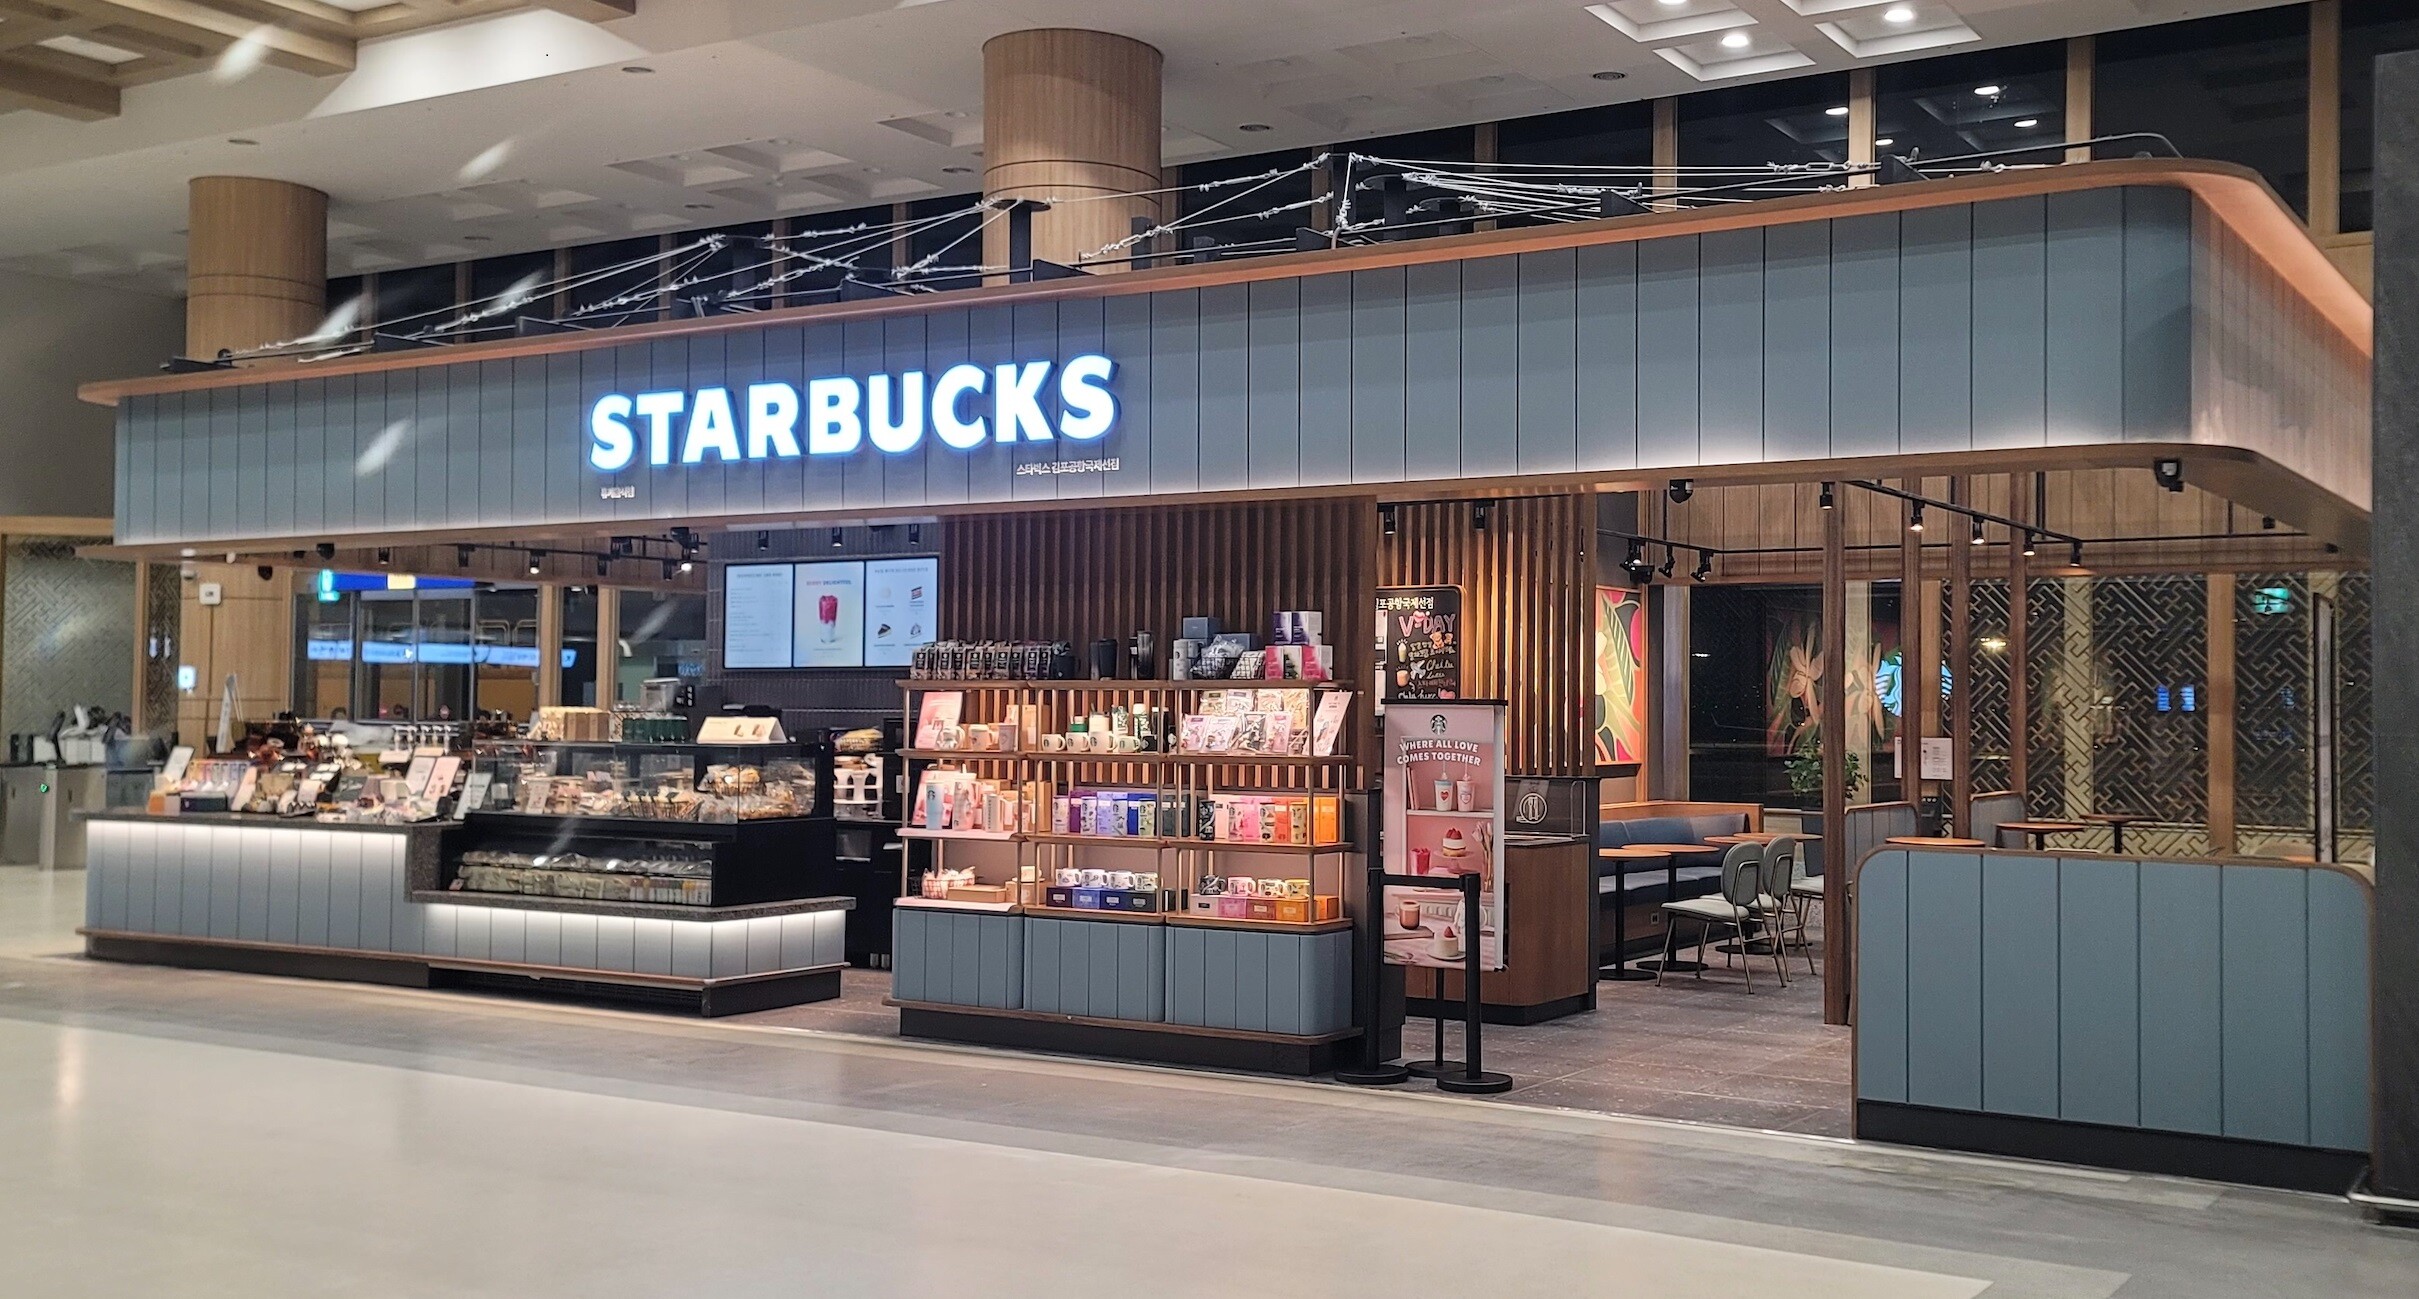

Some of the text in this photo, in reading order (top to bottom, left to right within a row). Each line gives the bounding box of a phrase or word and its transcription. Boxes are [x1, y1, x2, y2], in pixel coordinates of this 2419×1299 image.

[589, 354, 1117, 471] STARBUCKS
[1016, 457, 1120, 475] 스타벅스 김포공항국제선점
[1399, 739, 1479, 753] WHERE ALL LOVE
[1397, 752, 1481, 766] COMES TOGETHER
